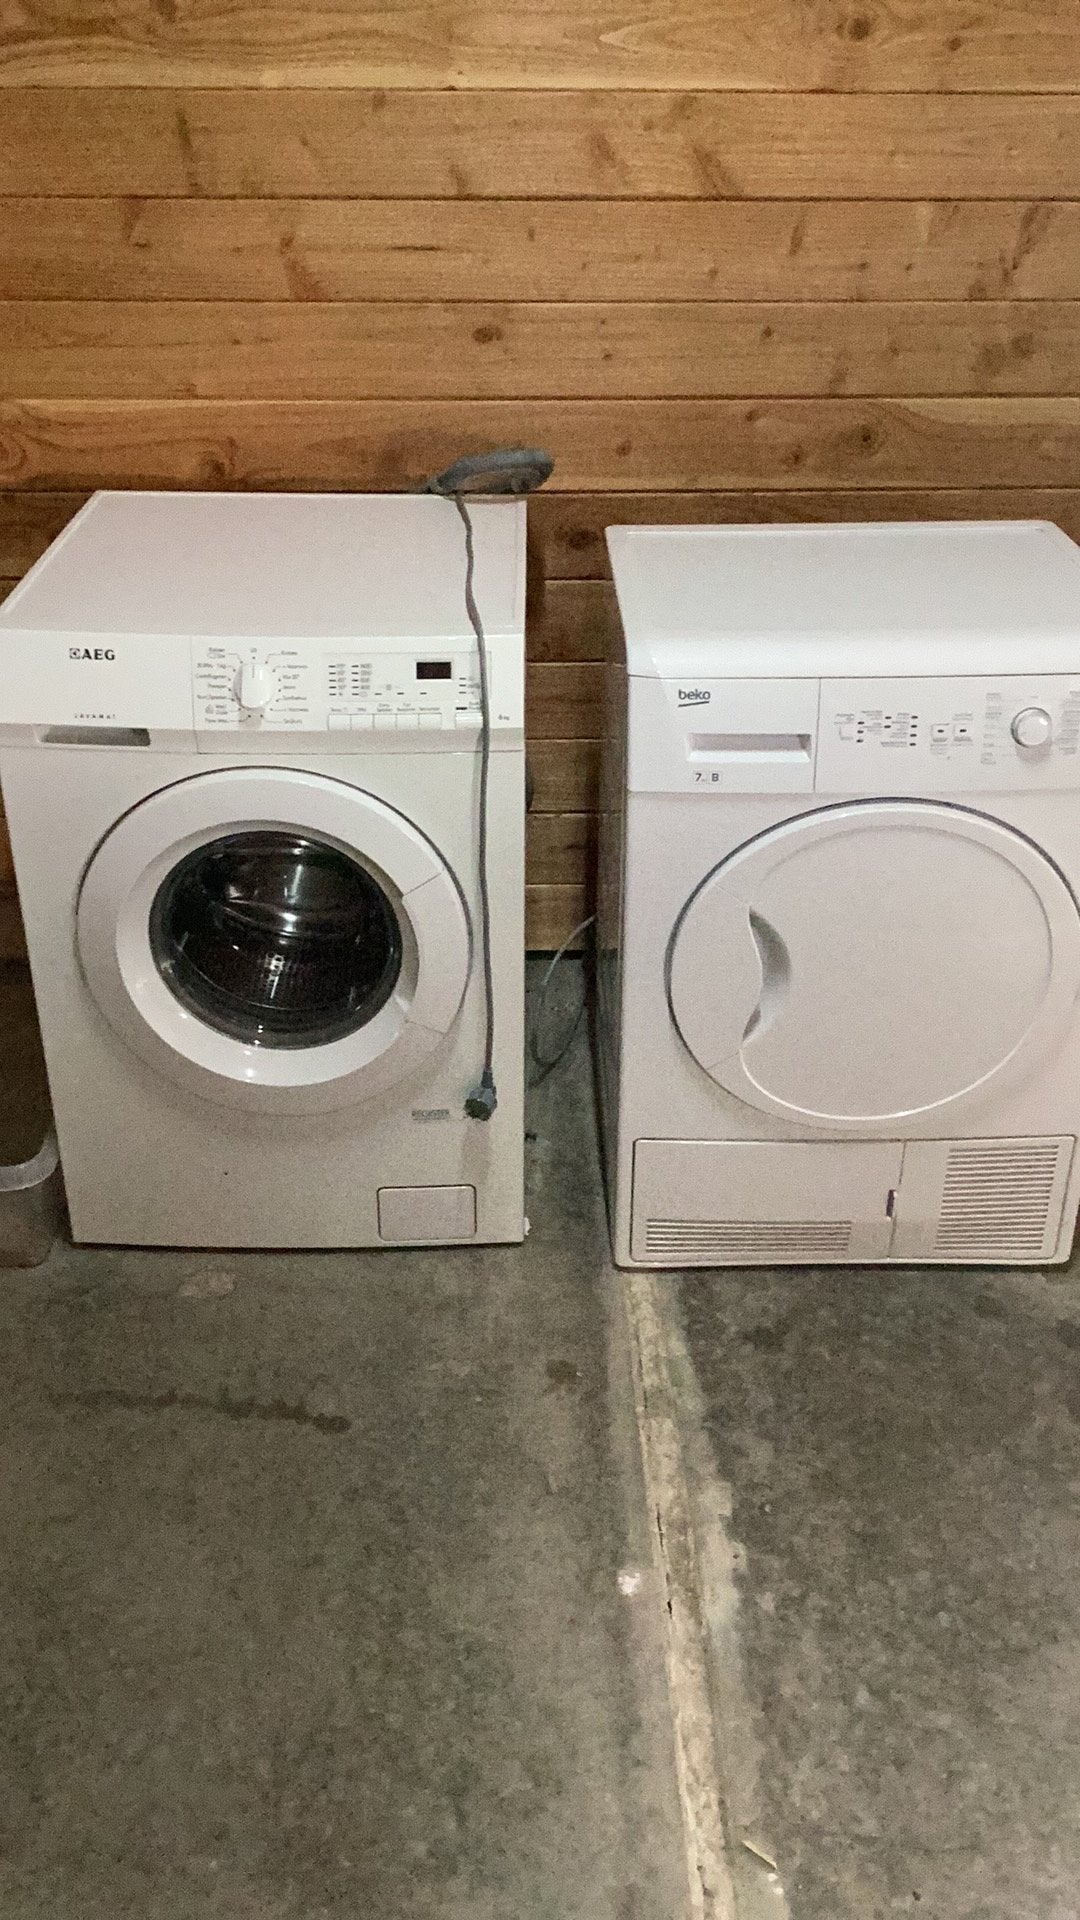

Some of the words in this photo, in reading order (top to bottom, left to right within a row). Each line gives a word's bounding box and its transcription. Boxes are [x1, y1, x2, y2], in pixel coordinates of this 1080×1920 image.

[81, 648, 116, 661] AEG
[678, 689, 711, 700] beko
[695, 772, 702, 782] 7
[711, 772, 719, 782] B
